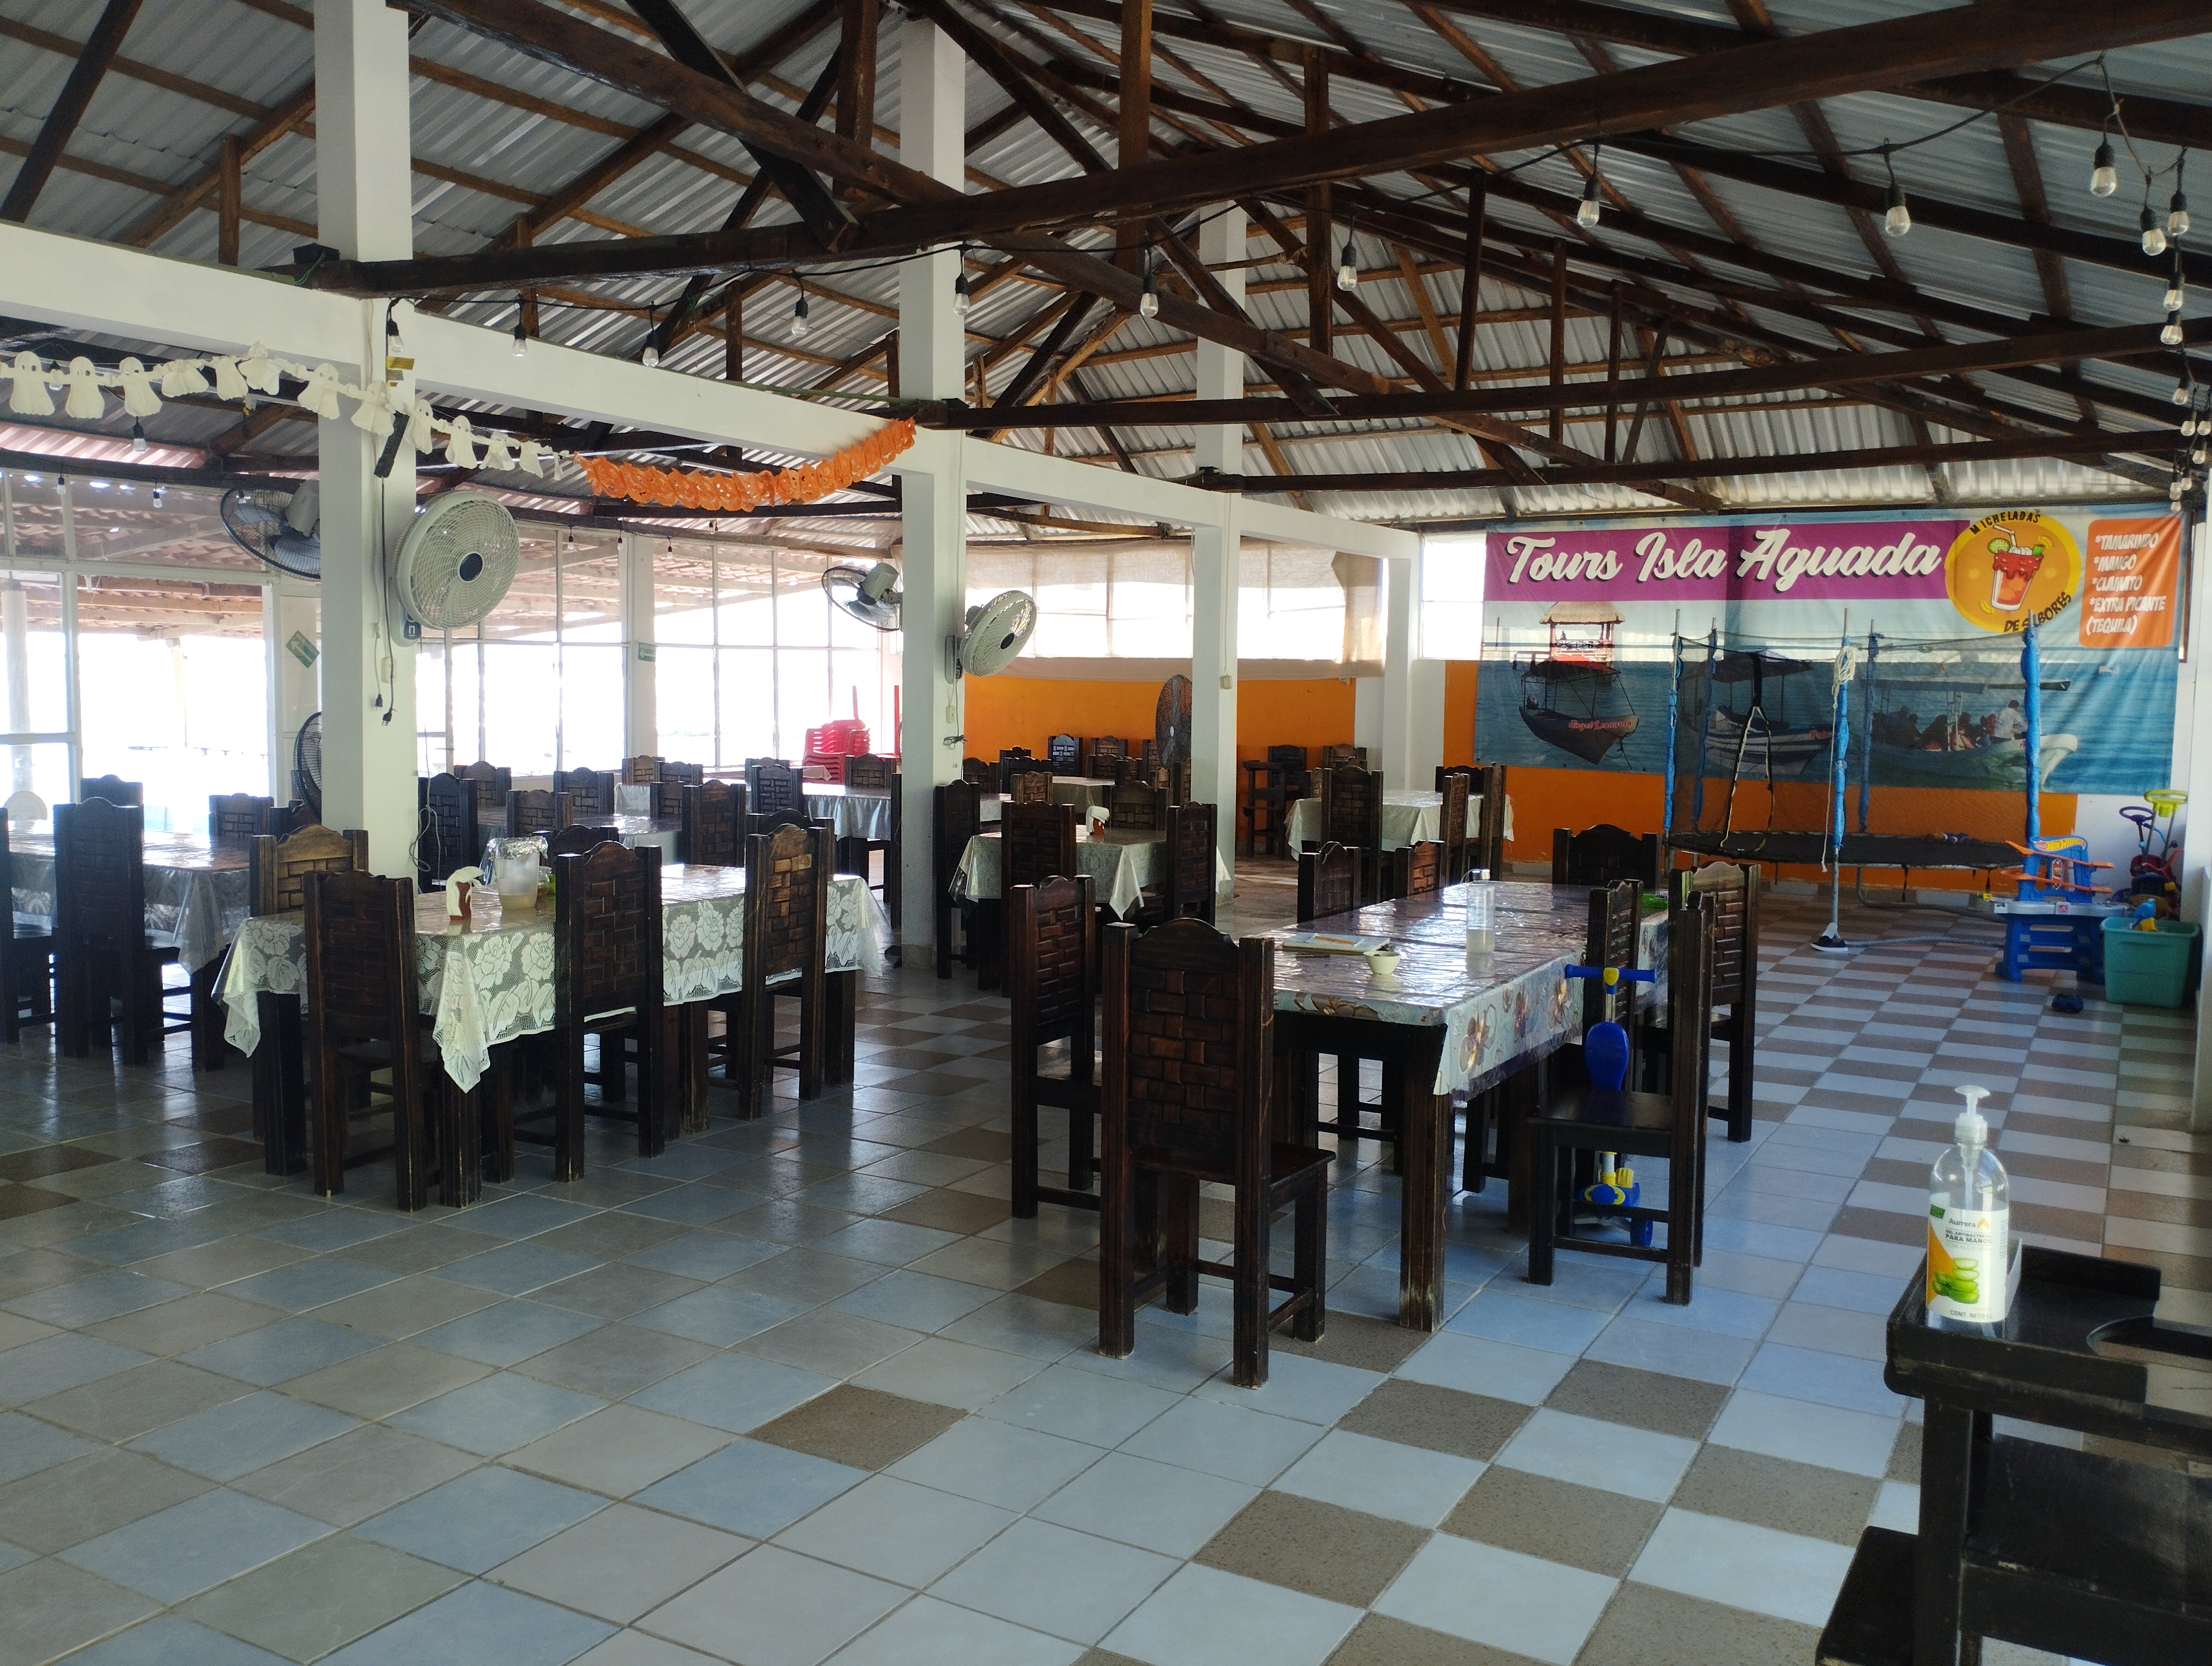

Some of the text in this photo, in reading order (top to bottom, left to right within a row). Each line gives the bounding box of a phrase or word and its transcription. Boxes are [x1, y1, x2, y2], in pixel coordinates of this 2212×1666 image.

[1970, 510, 2041, 535] MICHELADAS
[1506, 528, 1942, 592] Tours Isla Aguada
[2003, 591, 2072, 633] DE SBORES
[2125, 595, 2166, 612] PICANTE
[2086, 614, 2138, 637] (TEQUILA)
[1949, 1218, 1976, 1228] Aurrera
[1945, 1233, 1964, 1242] PARA
